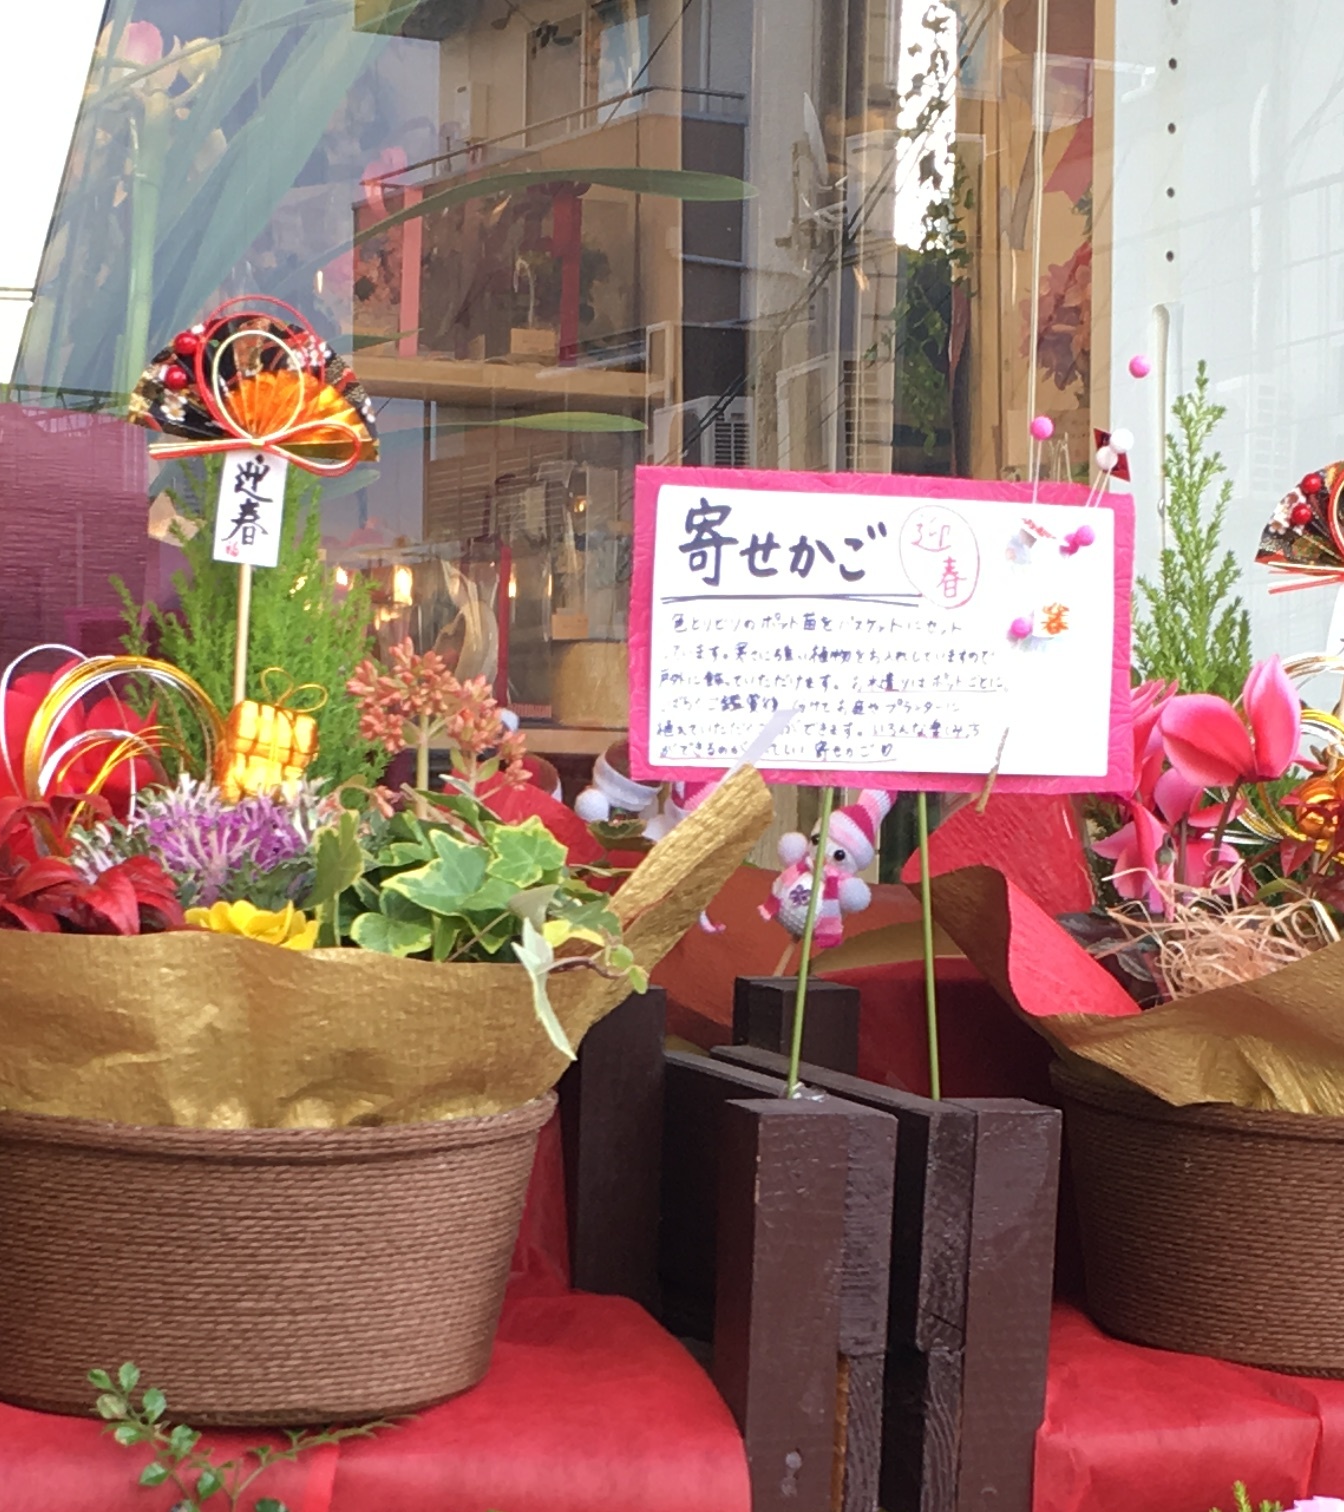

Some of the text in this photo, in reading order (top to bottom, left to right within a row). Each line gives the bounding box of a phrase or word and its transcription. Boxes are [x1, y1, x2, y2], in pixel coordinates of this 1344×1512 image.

[221, 454, 273, 545] 迎春
[678, 497, 888, 587] 寄せかご
[910, 516, 968, 599] 迎春
